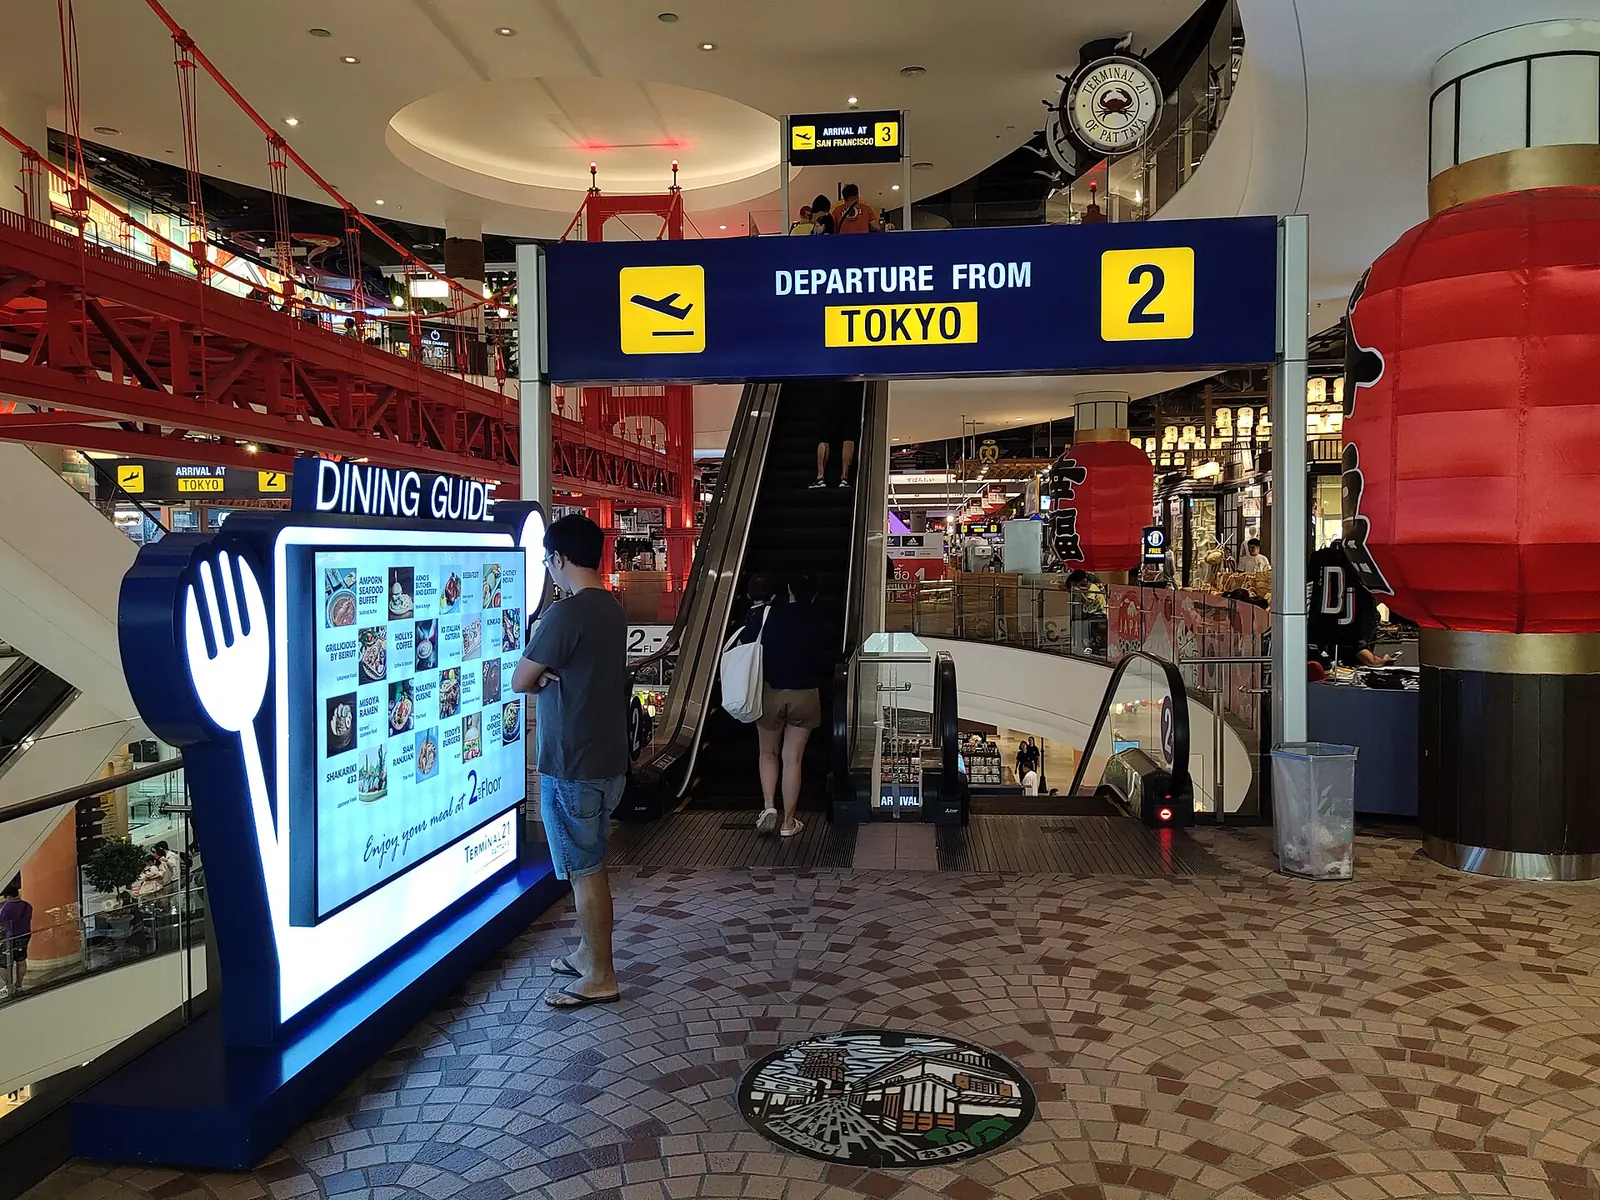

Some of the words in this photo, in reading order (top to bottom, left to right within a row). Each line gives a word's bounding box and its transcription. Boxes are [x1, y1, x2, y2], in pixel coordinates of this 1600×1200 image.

[1081, 67, 1135, 94] TERMINAL
[1136, 81, 1149, 94] 21
[822, 127, 854, 136] ARRIVAL
[857, 126, 868, 135] AT
[1084, 119, 1100, 133] OF
[882, 126, 891, 142] 3
[816, 139, 832, 147] SAN
[833, 138, 874, 147] FRANCISCO
[775, 265, 934, 296] DEPARTURE
[952, 261, 1031, 290] FROM
[1127, 264, 1165, 324] 2
[841, 306, 961, 343] TOKYO
[175, 466, 211, 476] ARRIVAL
[215, 466, 226, 475] AT
[183, 479, 219, 490] TOKYO
[266, 472, 278, 487] 2
[315, 459, 421, 517] DINING
[431, 475, 496, 522] GUIDE
[359, 576, 383, 586] AMPORN
[358, 585, 384, 595] SEAFOOD
[358, 595, 378, 605] BUFFET
[394, 631, 413, 642] HOLLYS
[627, 629, 646, 653] 2
[643, 645, 655, 653] FL
[325, 640, 357, 653] GRILLICIOUS
[395, 640, 413, 651] COFFEE
[330, 652, 340, 661] BY
[339, 649, 357, 659] BEIRUT
[359, 695, 380, 708] MISOYA
[359, 705, 379, 718] RAMEN
[632, 707, 640, 752] 2
[1164, 707, 1172, 754] 2
[442, 735, 461, 748] BURGERS
[402, 743, 414, 755] SIAM
[326, 763, 358, 783] SHAKARIKI
[347, 774, 357, 785] 432
[880, 796, 920, 806] ARIVAL
[363, 835, 400, 870] Enjoy
[402, 820, 428, 856] your
[430, 796, 454, 827] meal
[455, 793, 467, 814] at
